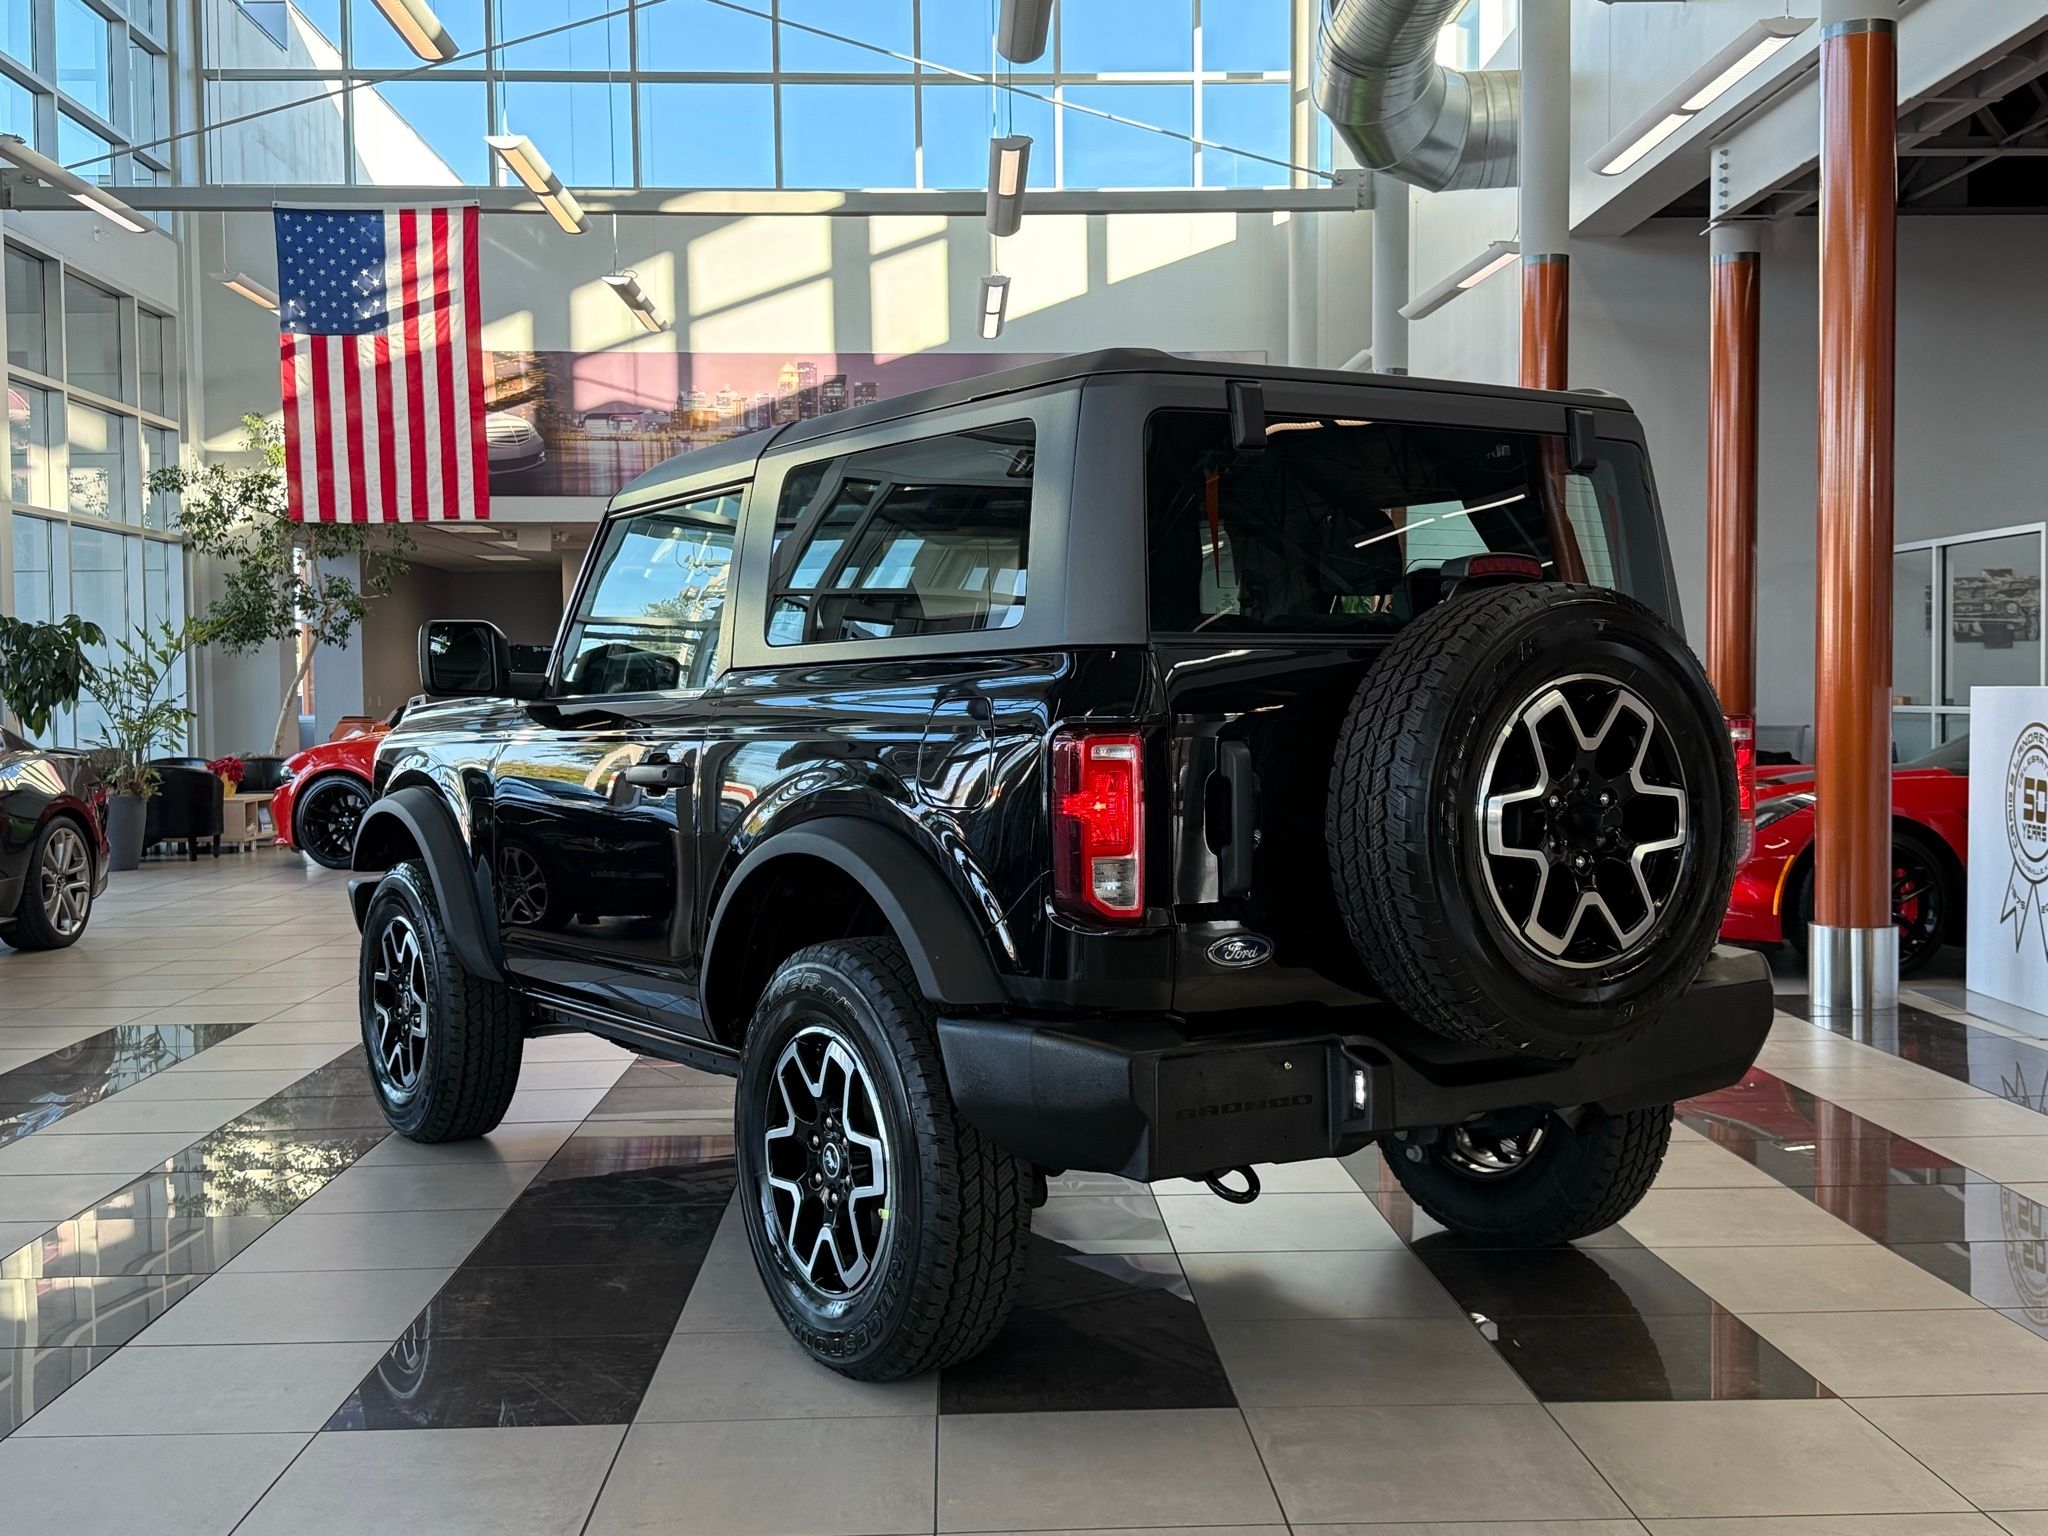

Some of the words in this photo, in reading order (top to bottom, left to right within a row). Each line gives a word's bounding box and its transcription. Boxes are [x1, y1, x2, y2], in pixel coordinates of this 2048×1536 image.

[2023, 776, 2047, 824] 50
[1223, 941, 1258, 960] Ford
[1176, 1094, 1313, 1120] BRONCO
